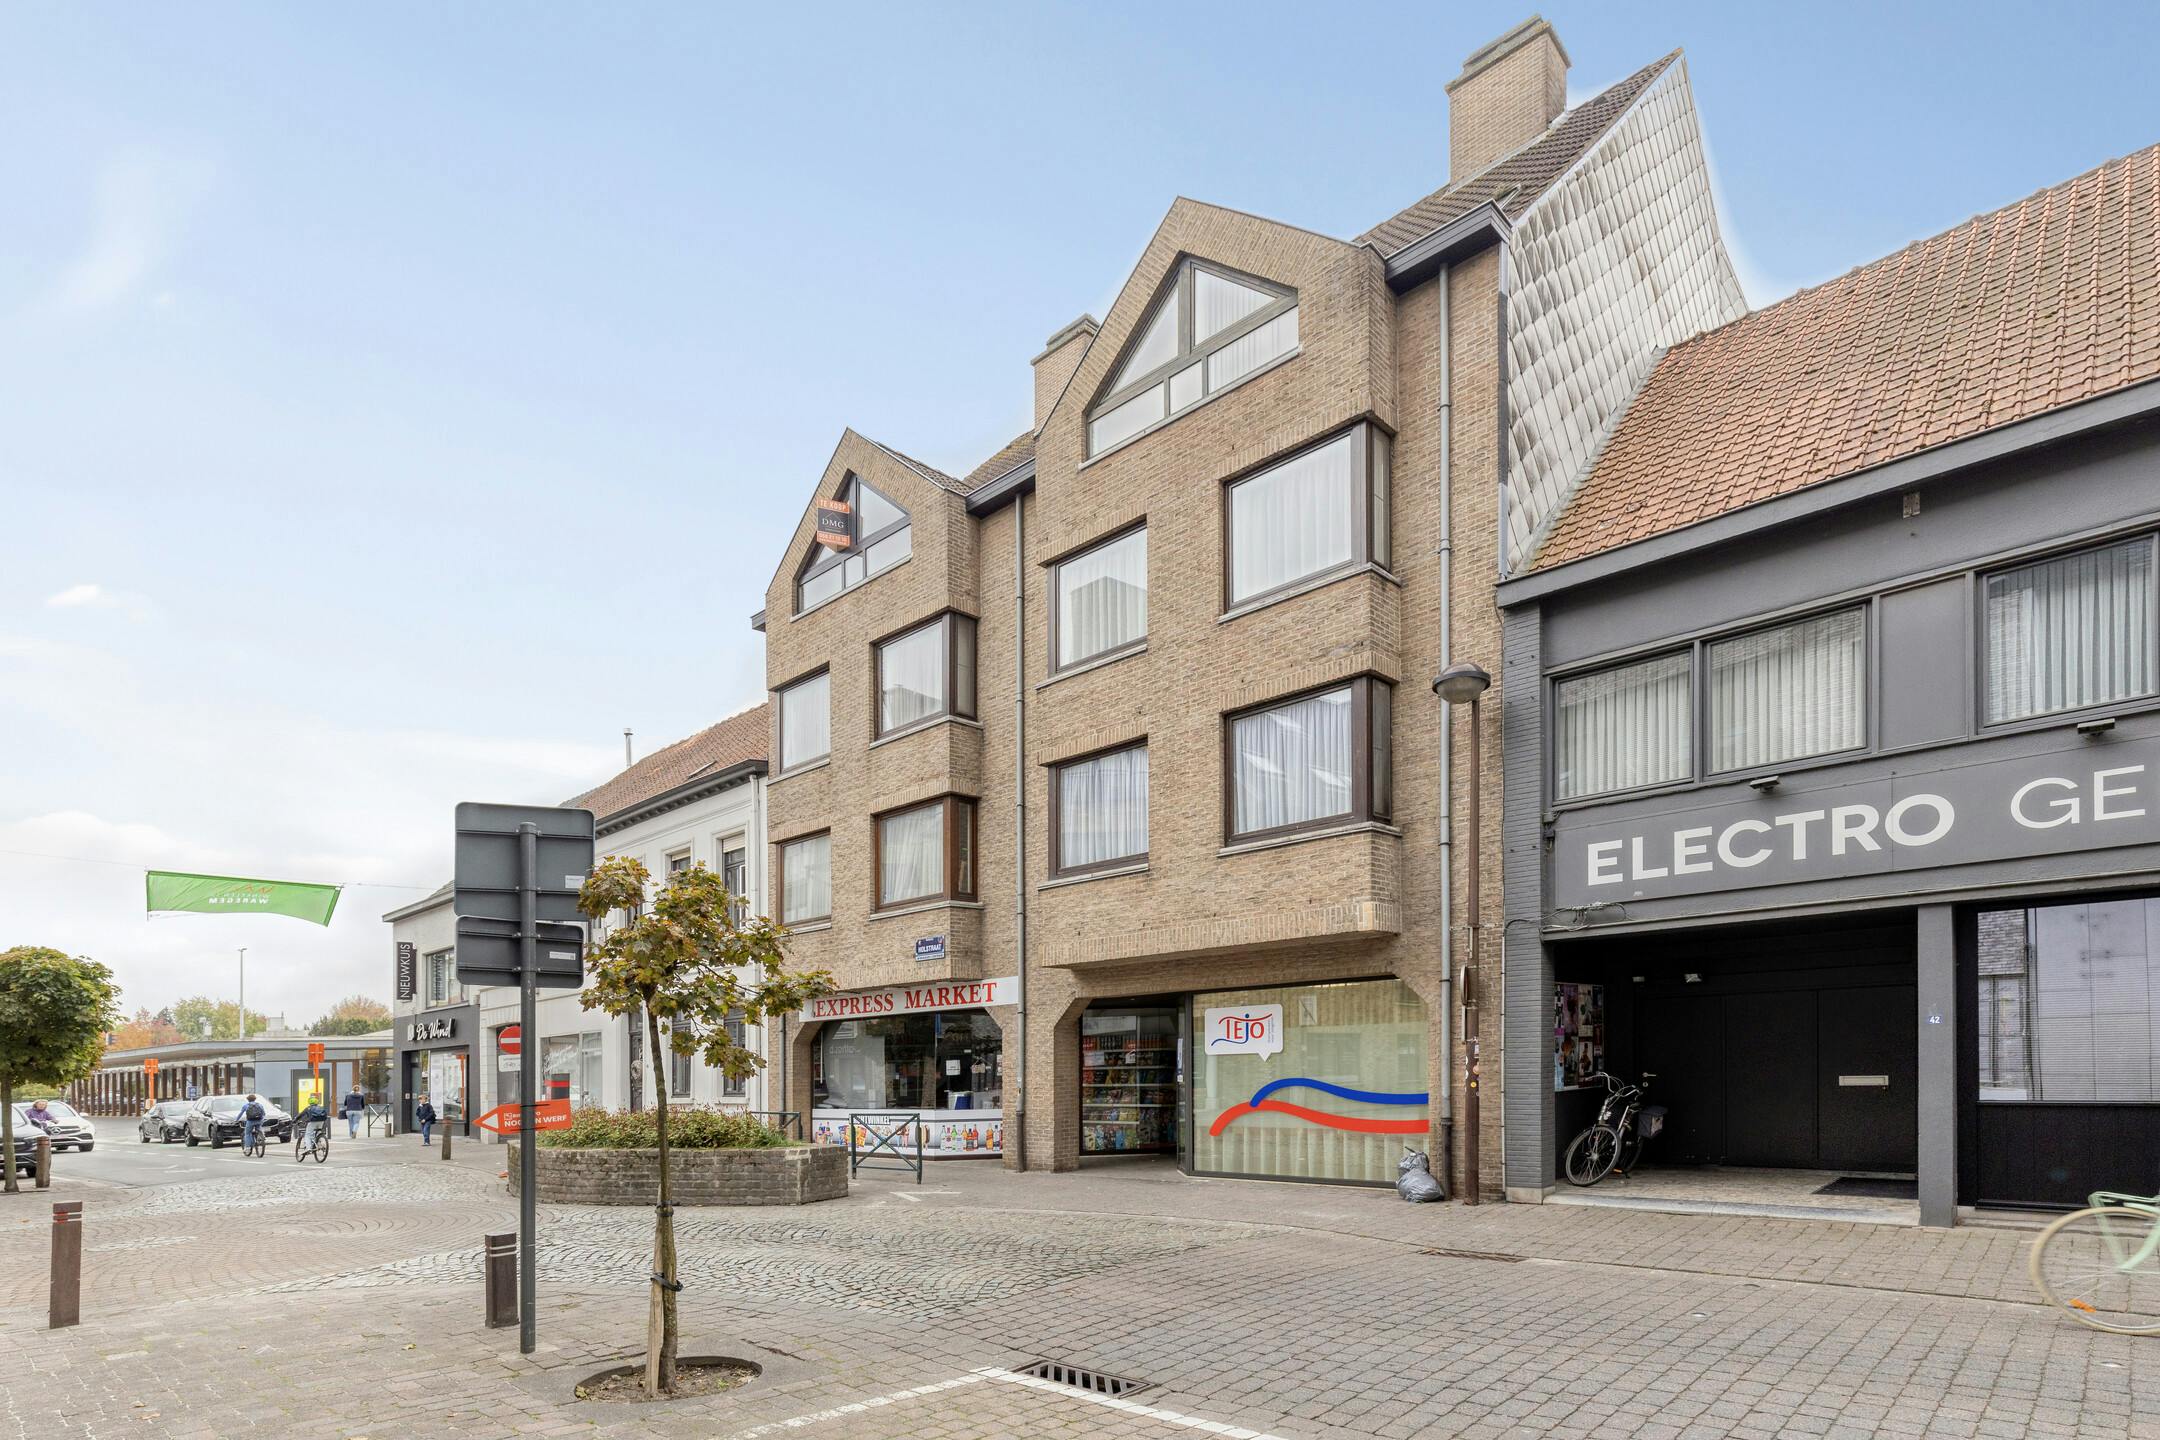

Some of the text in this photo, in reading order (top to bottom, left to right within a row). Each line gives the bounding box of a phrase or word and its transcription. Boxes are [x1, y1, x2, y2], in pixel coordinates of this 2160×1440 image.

[822, 518, 844, 529] DMG
[1586, 793, 1955, 887] ELECTRO
[917, 944, 942, 954] HOLSTRAAT
[399, 943, 411, 999] NIEUWKUIS
[815, 982, 998, 1018] EXPRESS MARKET
[1929, 1016, 1941, 1024] 42
[416, 1022, 427, 1041] De
[428, 1018, 452, 1039] Wind
[543, 1114, 567, 1124] WERF
